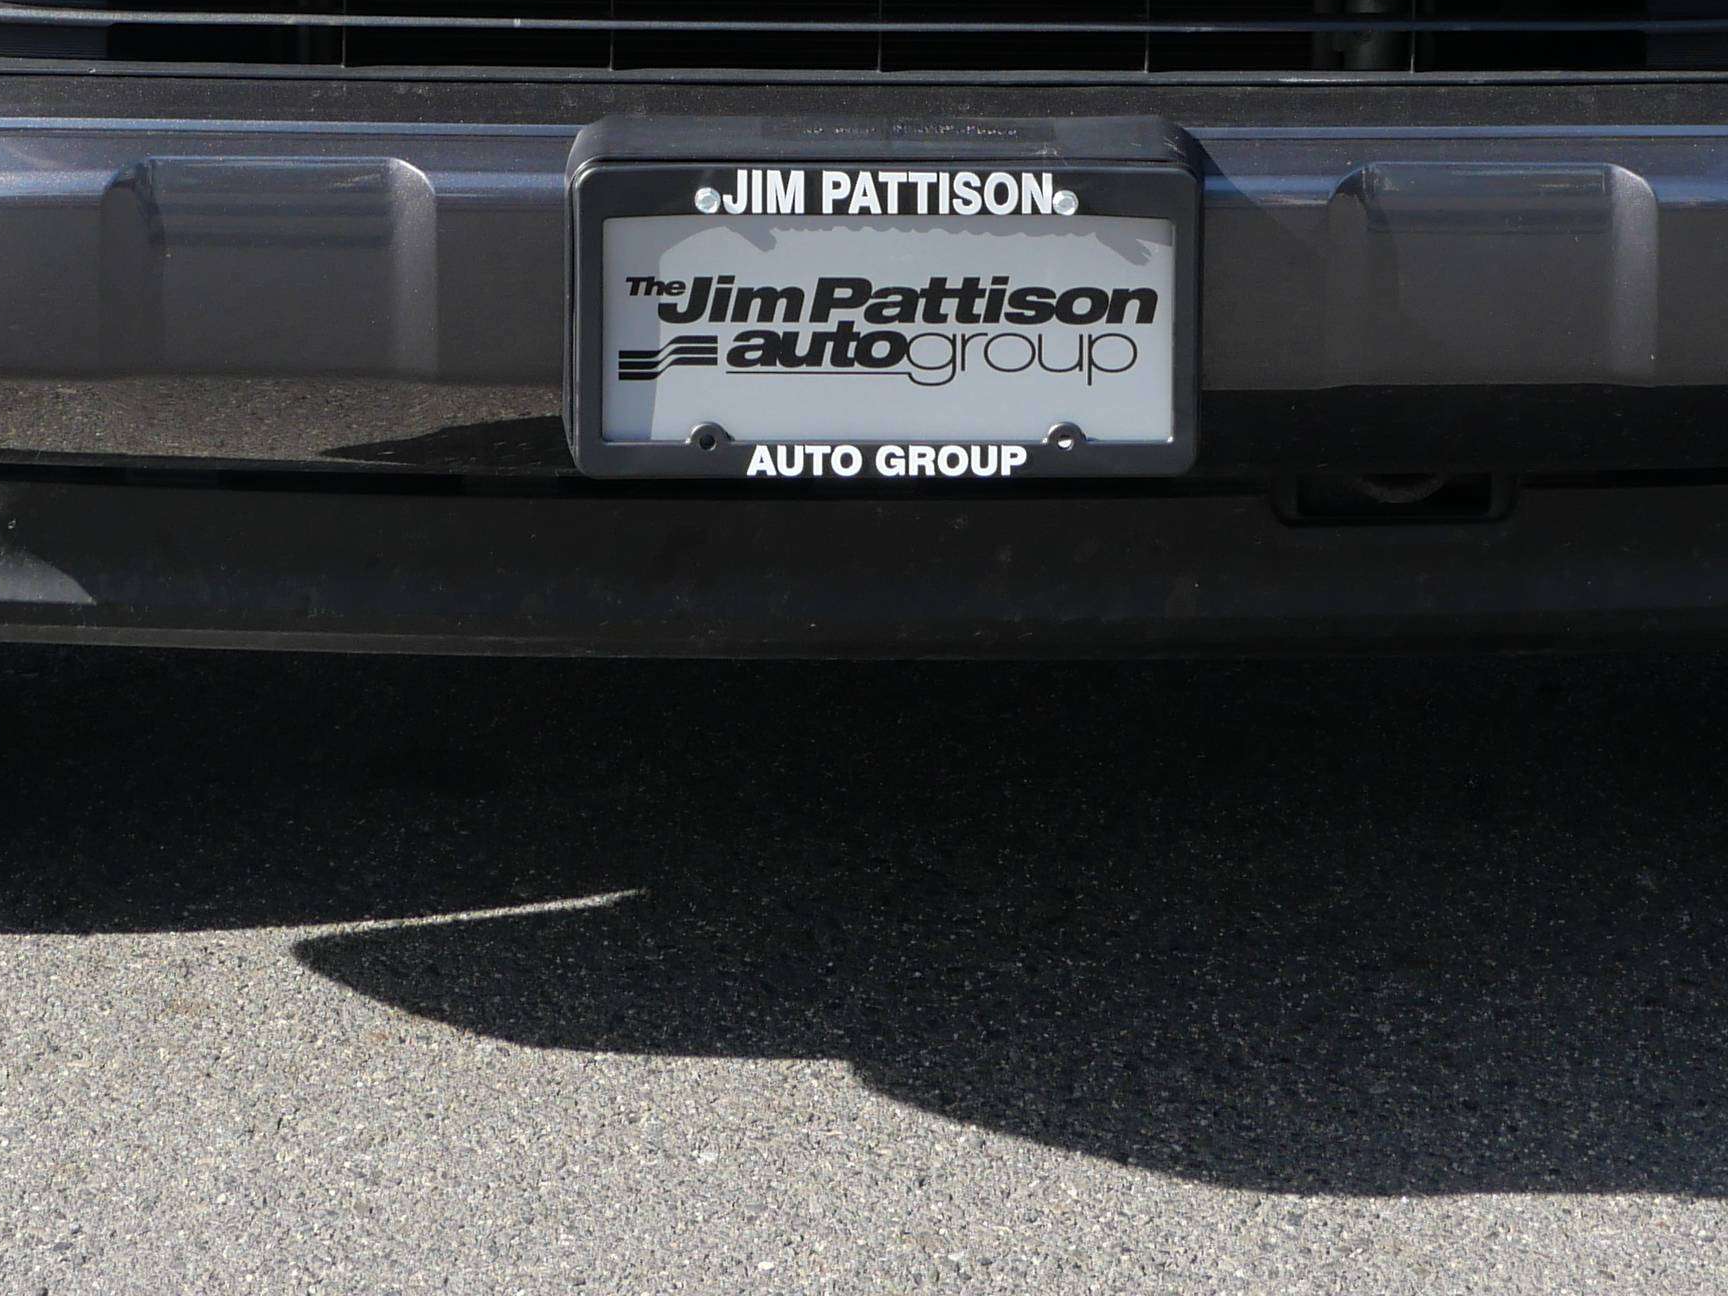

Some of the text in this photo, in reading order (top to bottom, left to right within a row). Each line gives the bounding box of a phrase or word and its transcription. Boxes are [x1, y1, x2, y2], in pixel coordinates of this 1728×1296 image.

[723, 169, 1054, 215] JIM PATTISON
[625, 275, 1158, 325] The Jim Pattison
[747, 445, 1028, 476] AUTO GROUP
